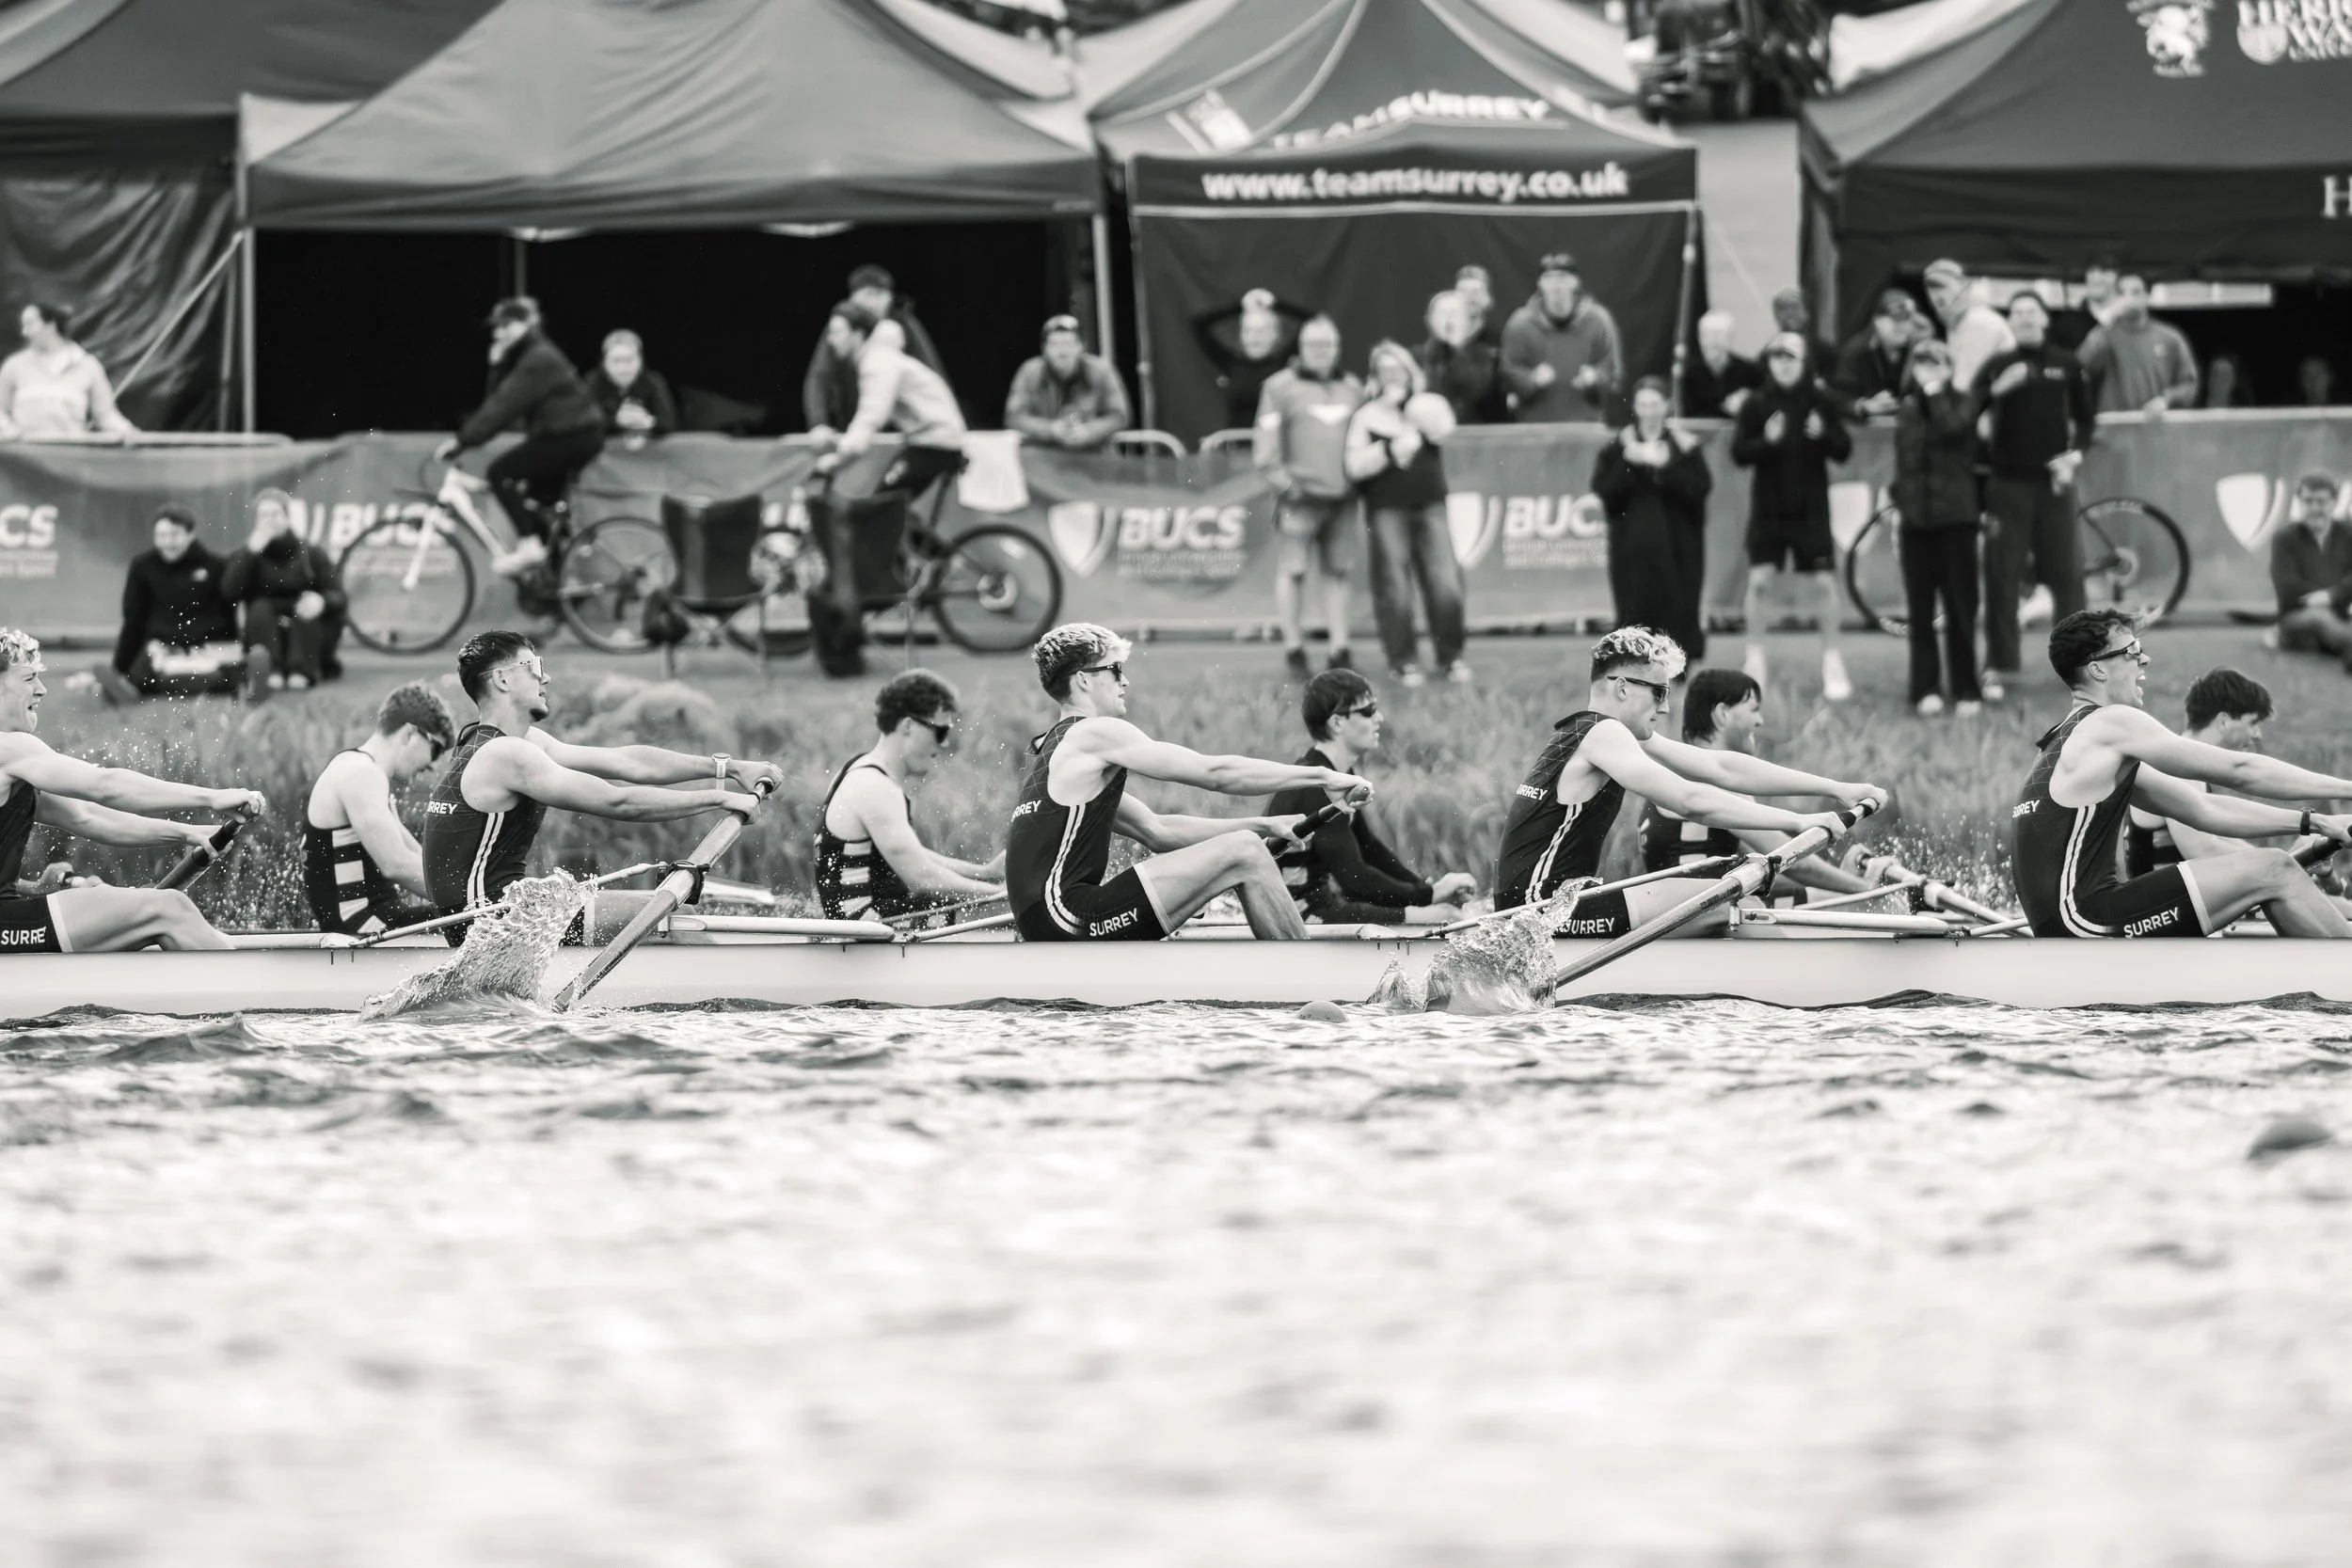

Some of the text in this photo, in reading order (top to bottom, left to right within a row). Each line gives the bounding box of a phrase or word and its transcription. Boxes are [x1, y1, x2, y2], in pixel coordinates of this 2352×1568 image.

[1201, 162, 1628, 204] www.teamsurrey.co.uk
[1117, 505, 1248, 549] BUCS
[1503, 494, 1608, 538] BUC
[0, 926, 47, 945] SURRE
[1089, 907, 1138, 937] SURREY
[2123, 907, 2179, 939] SURREY
